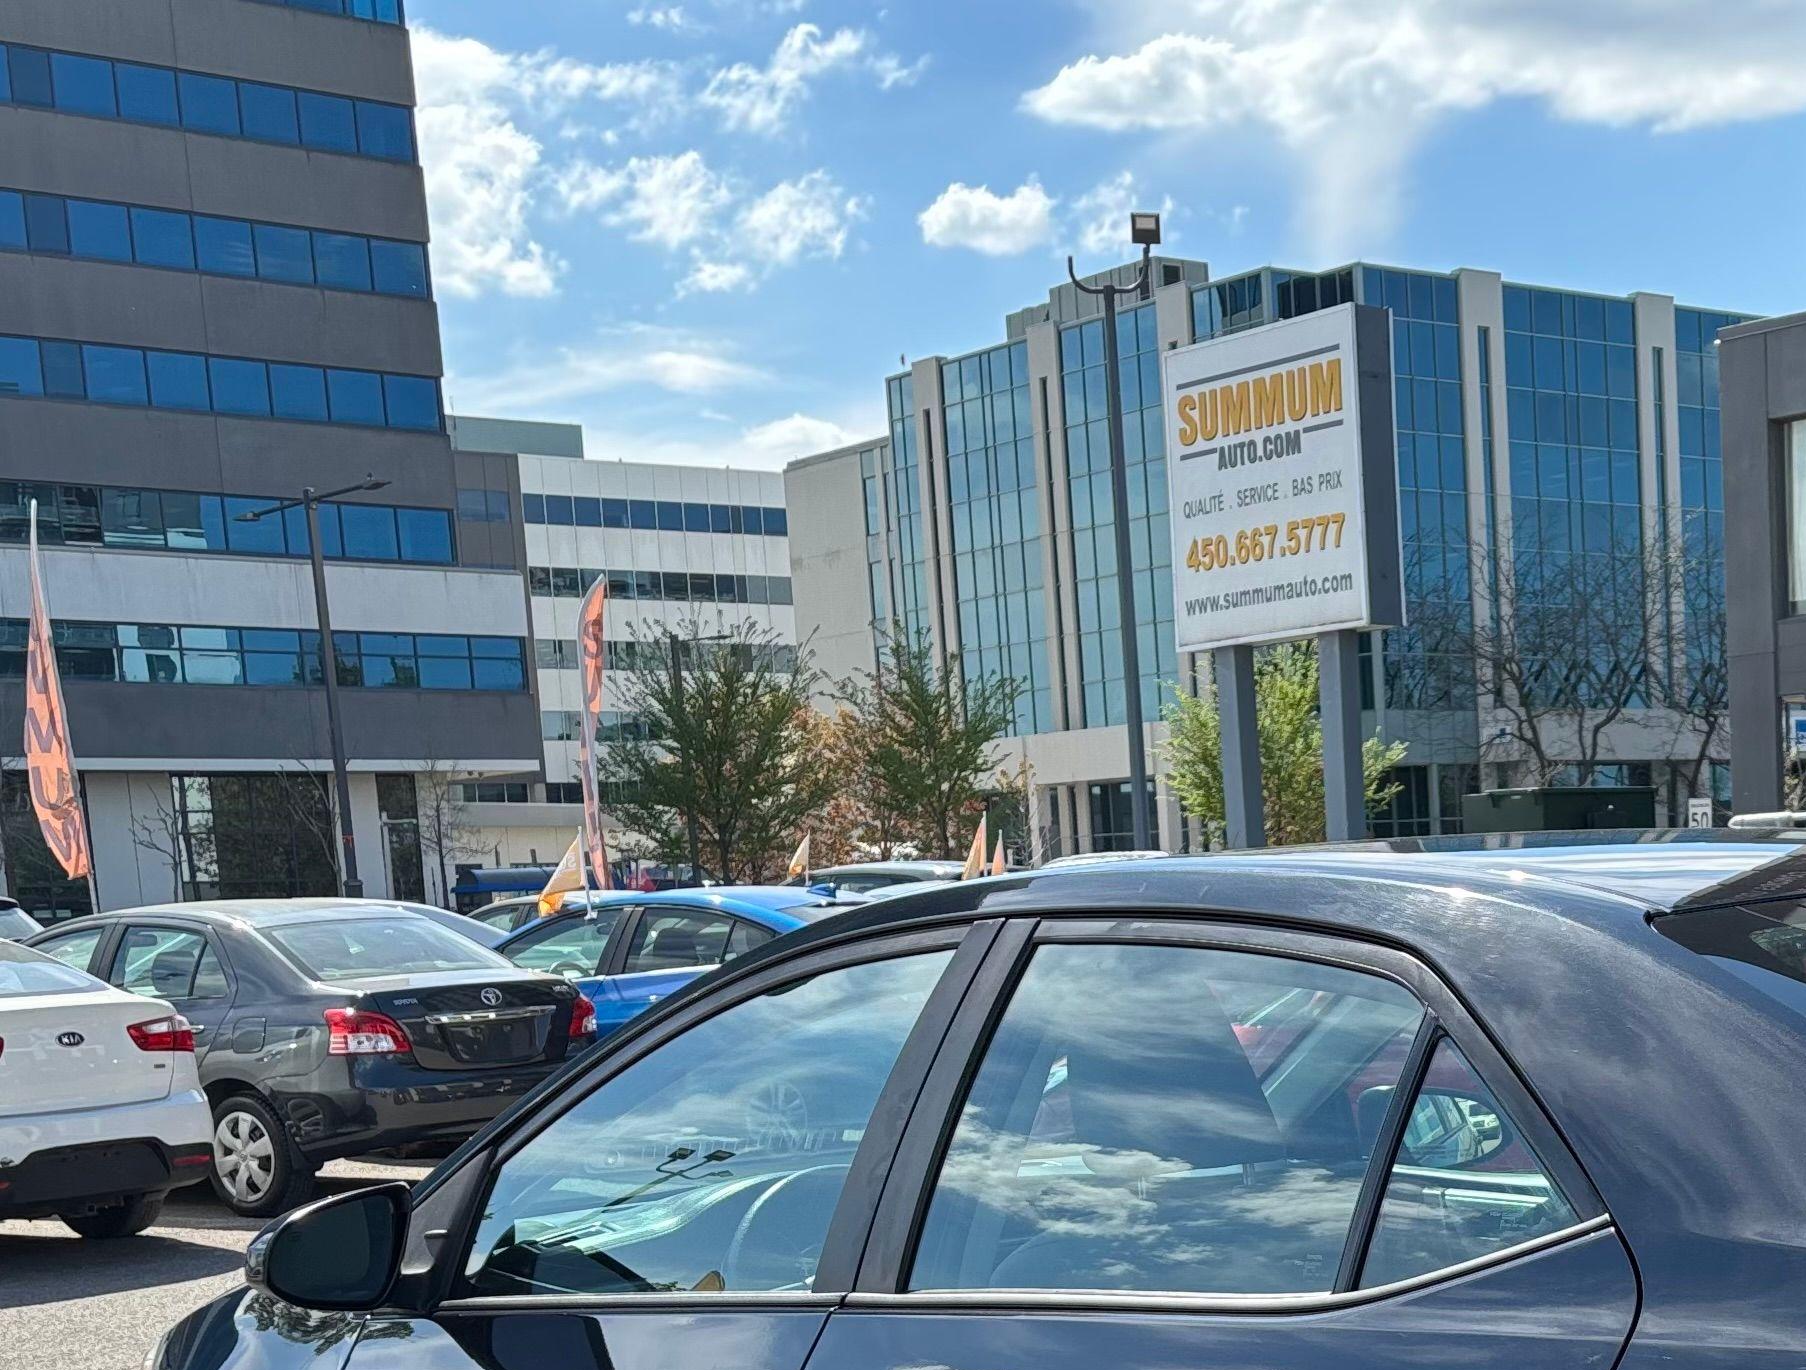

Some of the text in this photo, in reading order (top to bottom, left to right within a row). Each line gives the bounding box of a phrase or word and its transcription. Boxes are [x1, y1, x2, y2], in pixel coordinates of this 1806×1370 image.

[1177, 358, 1343, 447] SUMMUM
[1217, 429, 1302, 471] AUTO.COM
[1183, 469, 1343, 520] QUALITÉ SERVICE BAS PRIX
[1185, 512, 1346, 573] 450.667.5777
[1185, 571, 1353, 617] www.summumauto.com
